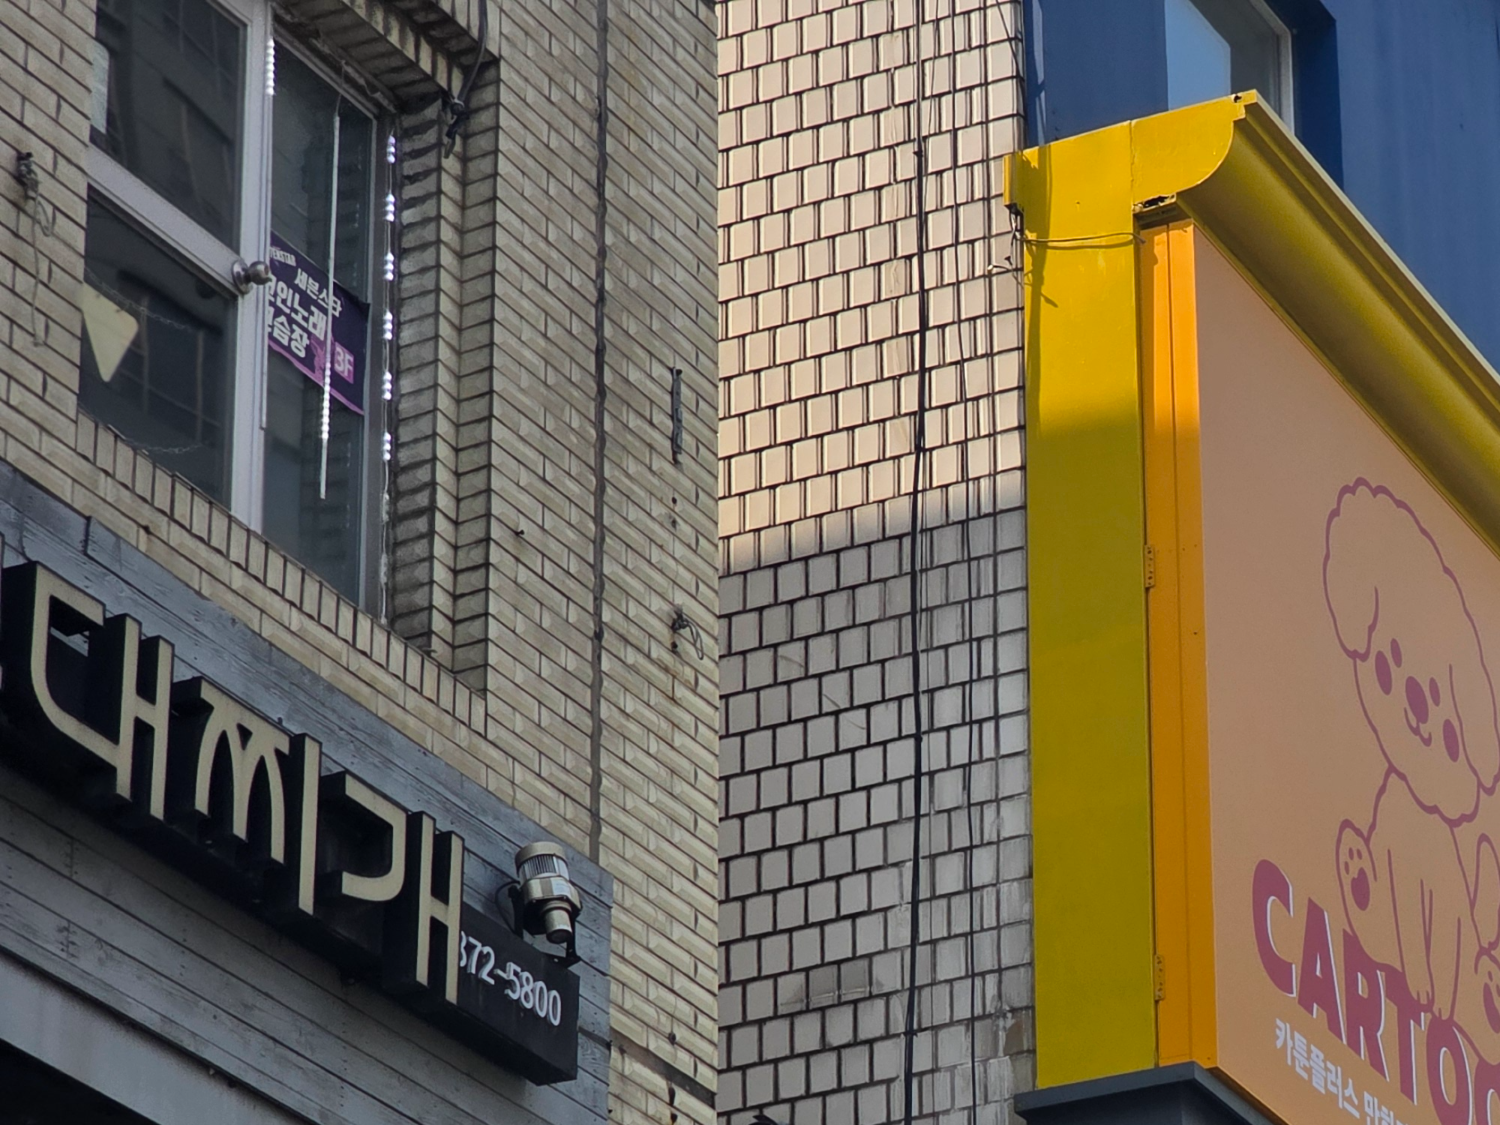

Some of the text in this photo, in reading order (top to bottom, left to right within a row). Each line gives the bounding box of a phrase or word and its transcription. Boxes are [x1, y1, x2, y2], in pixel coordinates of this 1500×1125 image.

[334, 346, 354, 378] 3F
[0, 562, 464, 1006] 대찌개
[1275, 1018, 1361, 1119] 카툰플러스
